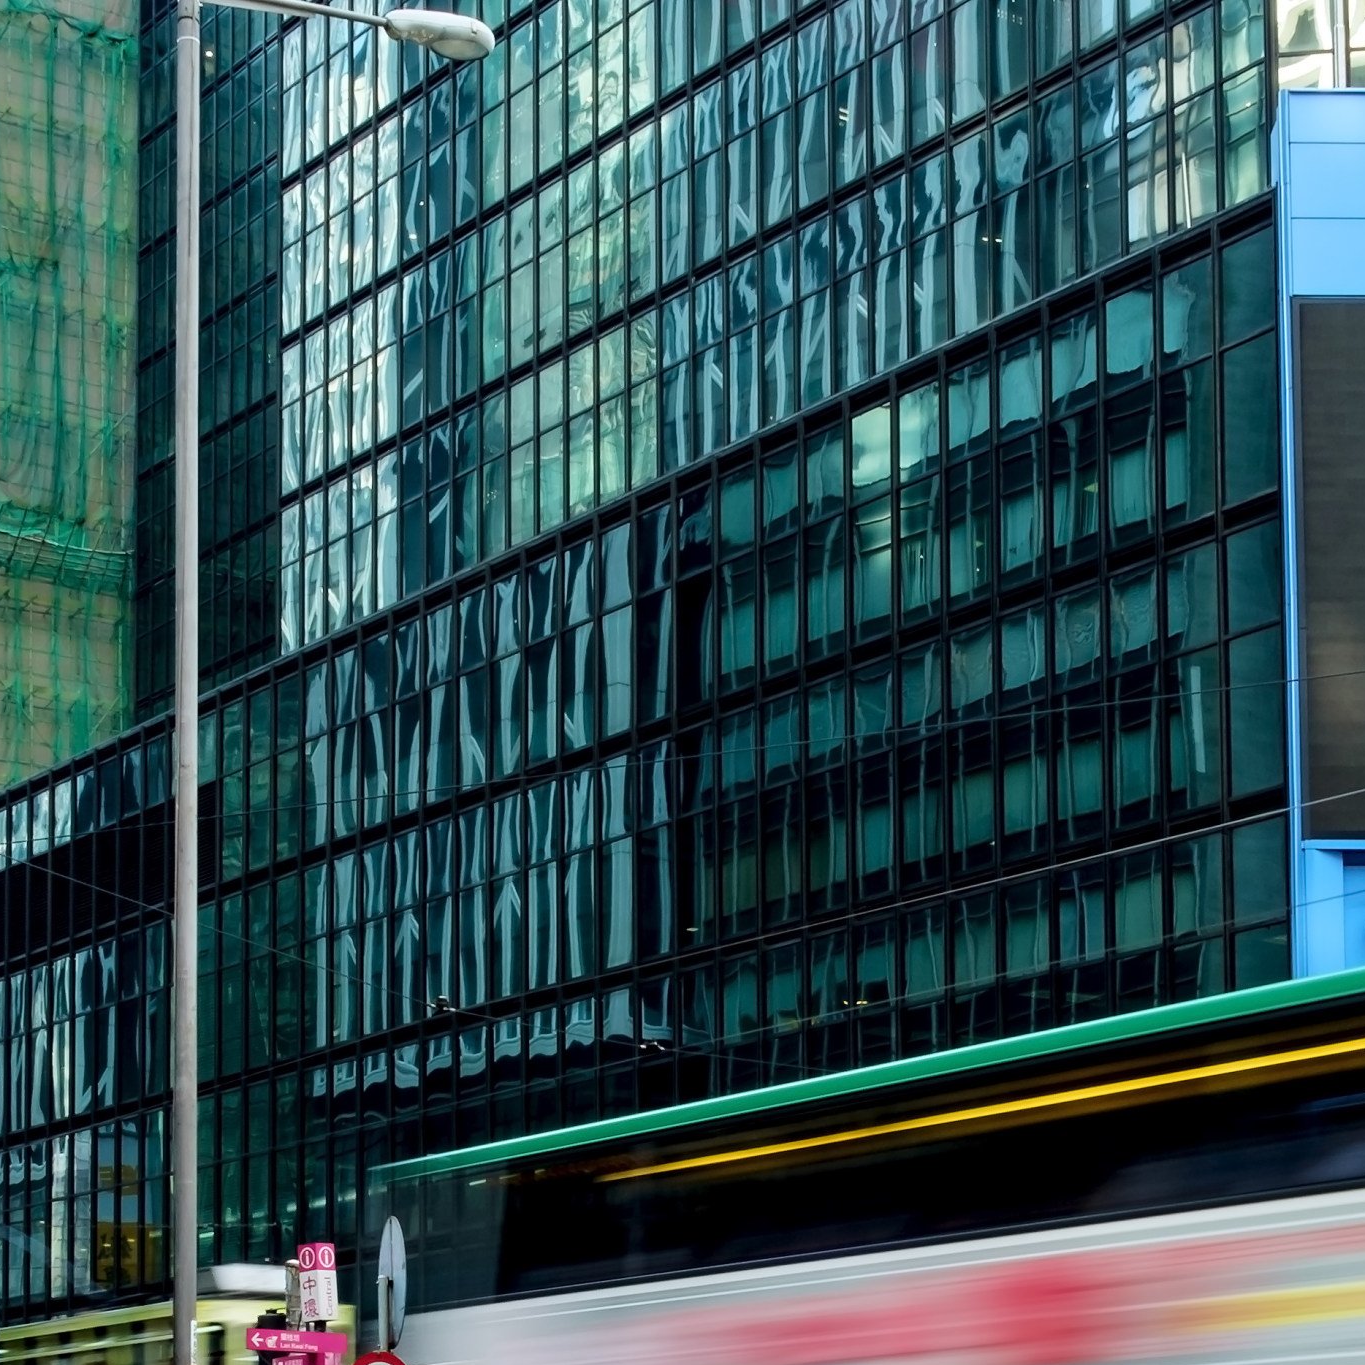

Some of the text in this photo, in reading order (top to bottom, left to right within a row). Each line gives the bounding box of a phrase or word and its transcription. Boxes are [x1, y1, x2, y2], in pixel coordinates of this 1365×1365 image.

[303, 1276, 319, 1317] 中環
[324, 1276, 334, 1317] Central
[304, 1344, 319, 1352] Fong
